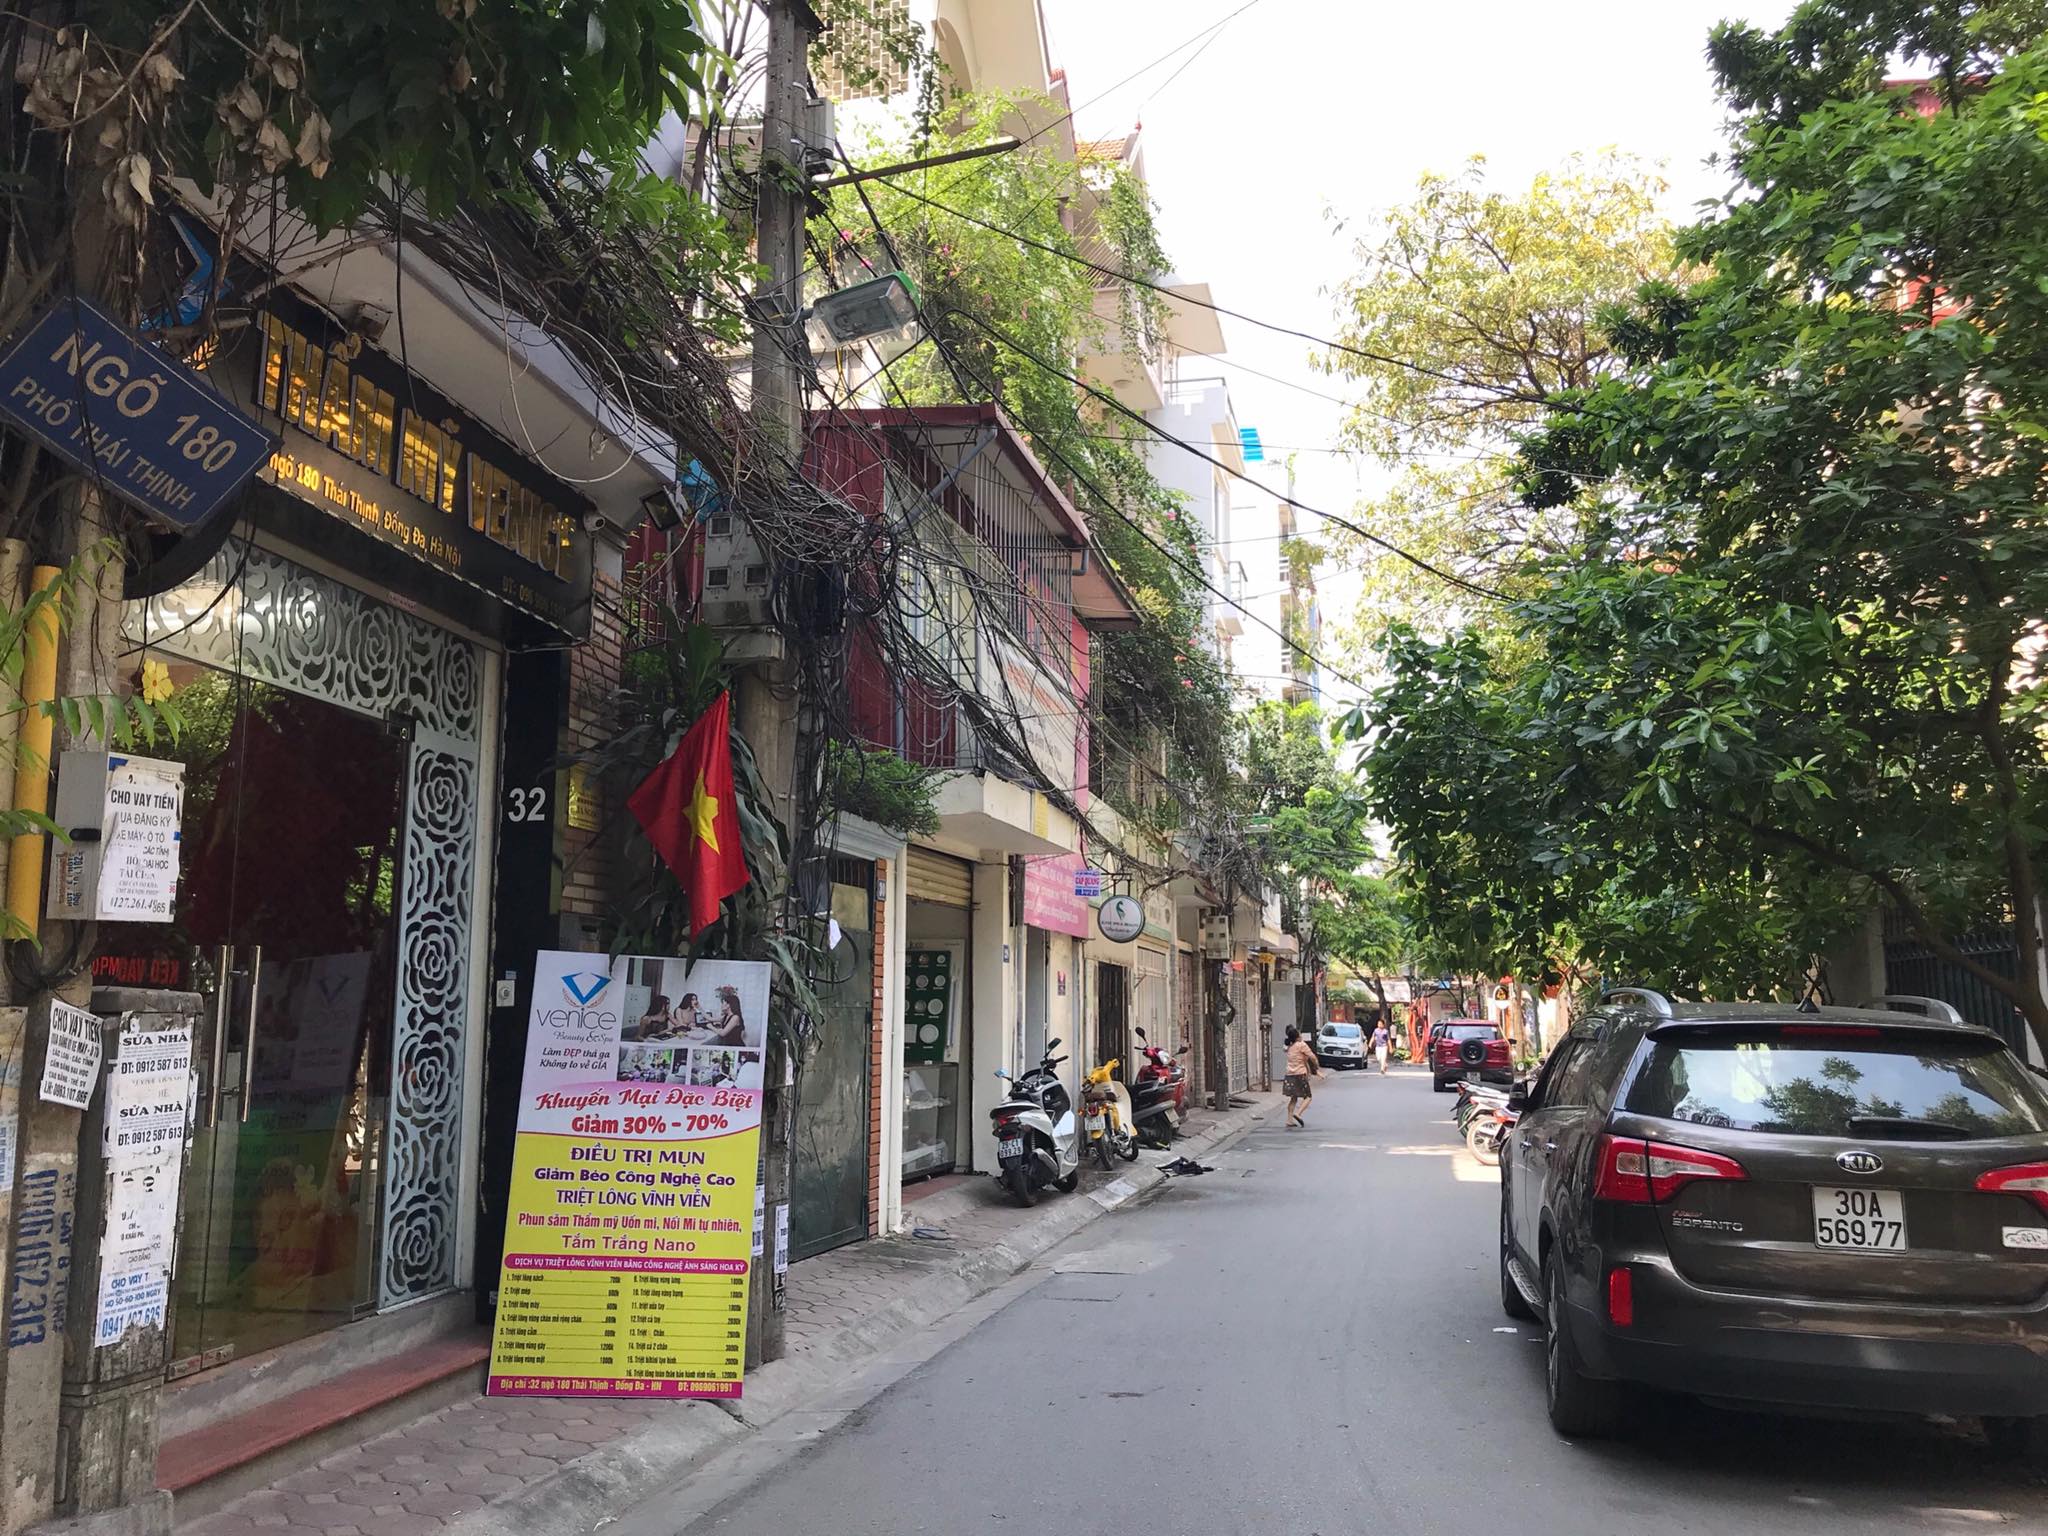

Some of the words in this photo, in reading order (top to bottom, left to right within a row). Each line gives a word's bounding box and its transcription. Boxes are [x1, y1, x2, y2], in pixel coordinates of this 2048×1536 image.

[49, 326, 169, 418] NGÕ
[165, 412, 238, 474] 180
[9, 375, 79, 427] PHỐ
[126, 455, 197, 511] THỊNH
[297, 462, 320, 492] 180
[323, 475, 348, 507] Thái
[383, 509, 410, 545] Đống
[430, 535, 443, 558] Hà
[444, 543, 462, 571] Nội
[111, 789, 132, 805] CHO
[133, 792, 152, 808] VAY
[507, 786, 547, 823] 32
[120, 811, 132, 824] UA
[52, 1007, 68, 1033] CHO
[68, 1012, 84, 1039] VAY
[535, 1007, 617, 1032] venice
[122, 1033, 153, 1047] SỬA
[158, 1031, 189, 1045] NHÀ
[553, 1030, 585, 1044] Beauty
[539, 1058, 568, 1071] Không
[569, 1060, 578, 1070] lo
[542, 1047, 562, 1057] Làm
[563, 1047, 582, 1059] ĐẸP
[598, 1051, 611, 1061] ga
[121, 1061, 135, 1075] ĐT:
[136, 1059, 156, 1074] 0912
[156, 1058, 172, 1072] 587
[173, 1056, 188, 1070] 613
[119, 1104, 149, 1118] SỬA
[153, 1100, 184, 1114] NHÀ
[535, 1087, 610, 1112] Khuyến
[617, 1087, 661, 1110] Mại
[664, 1087, 706, 1110] Đặc
[711, 1089, 754, 1113] Biệt
[571, 1113, 620, 1134] Giảm
[622, 1116, 667, 1135] 30%
[686, 1113, 729, 1133] 70%
[117, 1133, 131, 1147] ĐT:
[131, 1130, 151, 1144] 0912
[152, 1128, 167, 1142] 587
[168, 1126, 183, 1140] 613
[570, 1142, 617, 1162] ĐIỀU
[622, 1147, 652, 1167] TRỊ
[658, 1150, 706, 1168] MỤN
[1844, 1156, 1877, 1171] KIA
[534, 1166, 575, 1182] Giảm
[579, 1168, 610, 1183] Béo
[614, 1168, 656, 1186] Công
[660, 1171, 702, 1188] Nghệ
[706, 1172, 736, 1186] Cao
[556, 1186, 595, 1208] TRIỆT
[597, 1187, 637, 1206] LÔNG
[640, 1188, 675, 1207] VĨNH
[678, 1188, 712, 1208] VIỄN
[1834, 1190, 1883, 1219] 30A
[518, 1212, 545, 1227] Phun
[602, 1214, 619, 1230] mỹ
[621, 1213, 642, 1229] Uốn
[643, 1215, 660, 1231] mi,
[662, 1214, 681, 1230] Nối
[682, 1217, 697, 1230] Mi
[698, 1217, 710, 1235] tự
[1671, 1217, 1744, 1232] SORENTO
[1818, 1217, 1903, 1249] 569.77
[561, 1233, 597, 1250] Tắm
[602, 1233, 649, 1254] Trắng
[653, 1237, 697, 1252] Nano
[514, 1256, 533, 1267] DỊCH
[533, 1257, 545, 1268] VỤ
[545, 1256, 565, 1268] TRIỆT
[566, 1256, 586, 1267] LÔNG
[586, 1258, 605, 1269] VĨNH
[606, 1257, 624, 1269] VIỄN
[623, 1258, 643, 1269] BẰNG
[643, 1258, 664, 1270] CÔNG
[664, 1261, 684, 1271] NGHỆ
[684, 1259, 699, 1271] ÁNH
[699, 1260, 719, 1271] SÁNG
[719, 1262, 734, 1272] HOA
[101, 1313, 124, 1339] 0941
[500, 1378, 513, 1391] Địa
[571, 1378, 588, 1391] Thái
[588, 1379, 609, 1392] Thịnh
[615, 1379, 634, 1392] Đống
[634, 1380, 645, 1391] Đa
